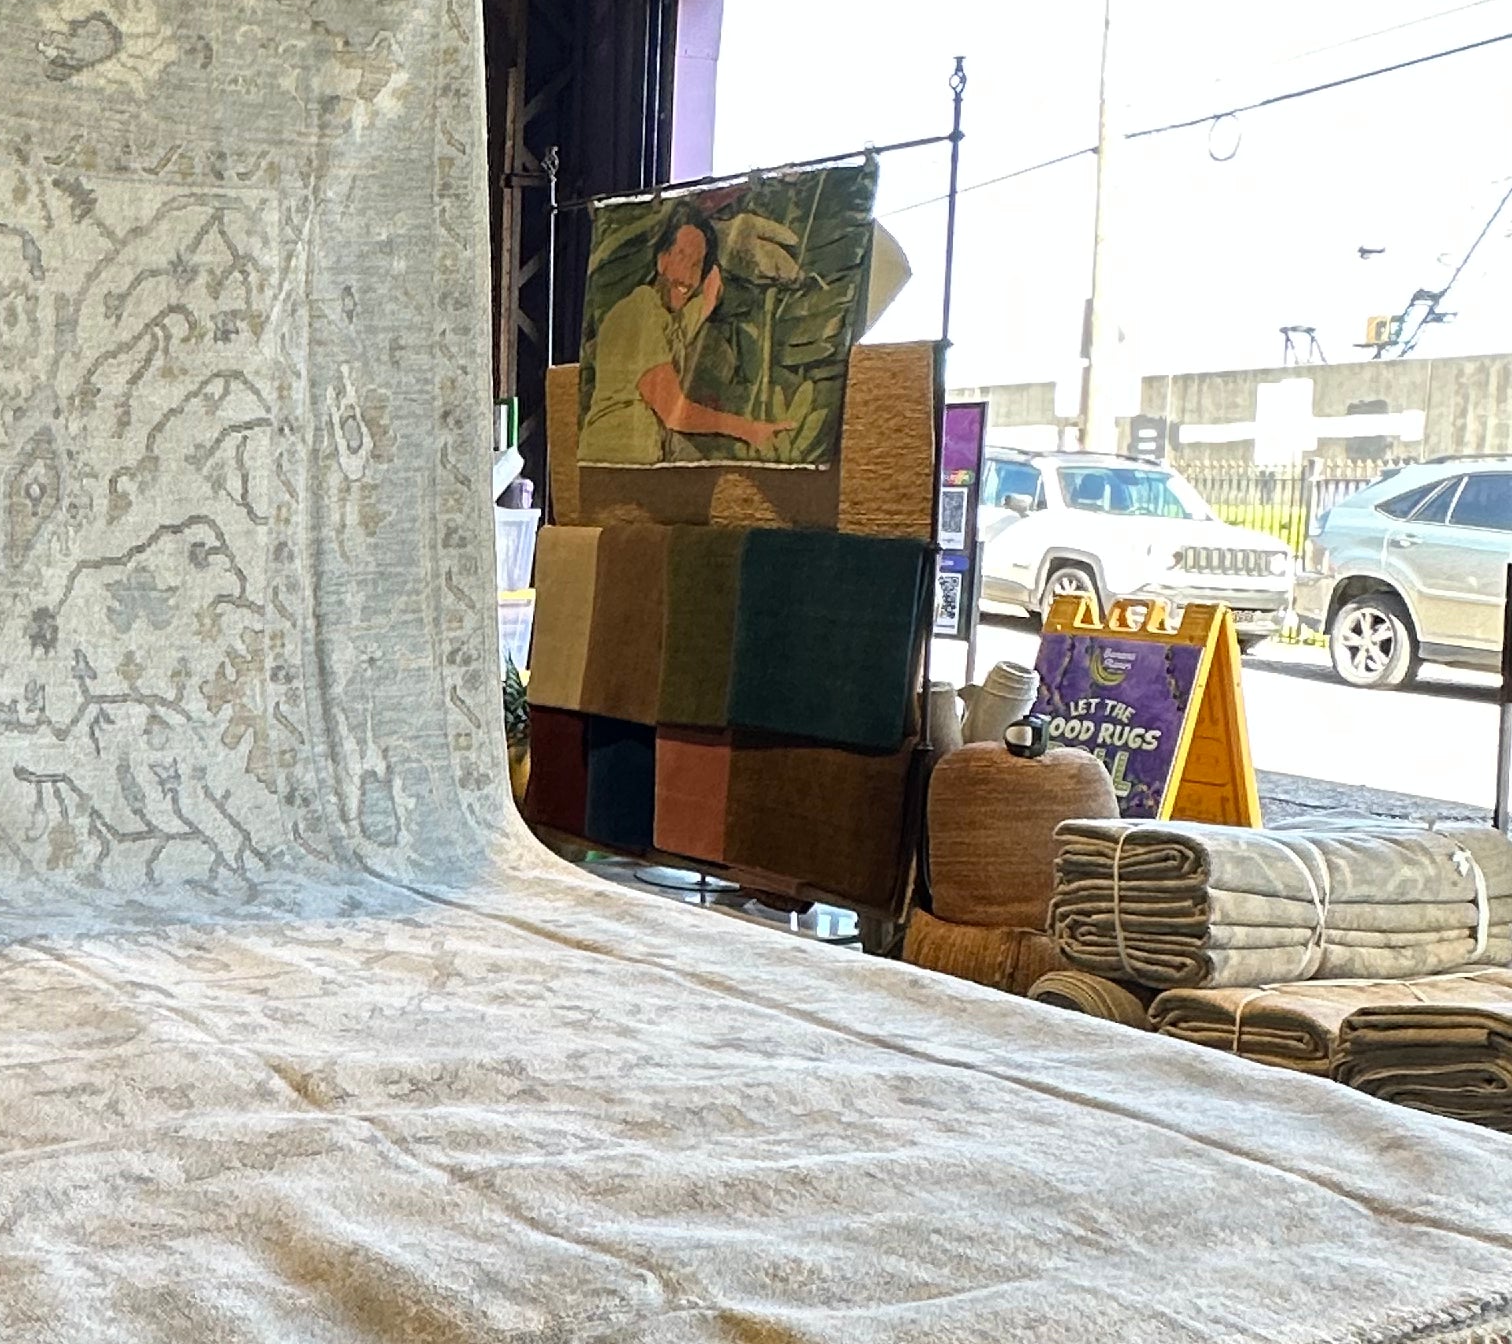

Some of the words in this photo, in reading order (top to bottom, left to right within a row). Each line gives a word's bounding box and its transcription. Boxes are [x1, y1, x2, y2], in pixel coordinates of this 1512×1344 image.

[1070, 698, 1101, 716] LET
[1104, 698, 1136, 724] THE
[1043, 714, 1095, 741] OOD
[1096, 722, 1162, 750] RUGS
